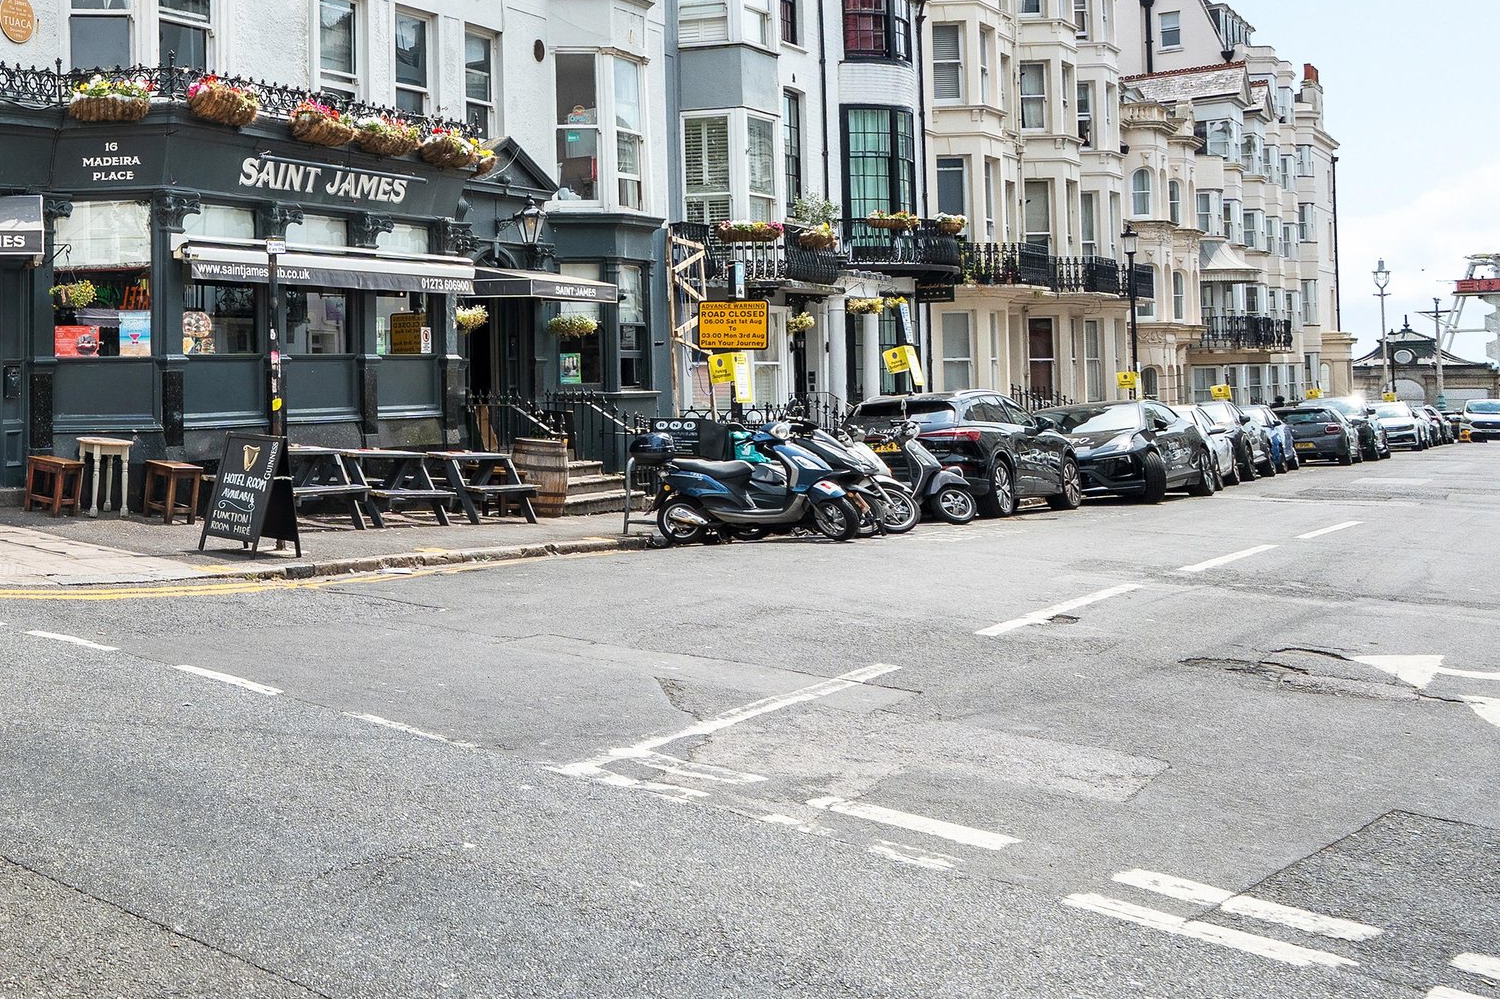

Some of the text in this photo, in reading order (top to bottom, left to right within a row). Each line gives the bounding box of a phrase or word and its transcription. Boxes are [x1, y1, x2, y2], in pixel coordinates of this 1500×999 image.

[3, 16, 32, 30] TUACA
[105, 142, 118, 152] 16
[82, 156, 141, 167] MADEIRA
[93, 171, 134, 181] PLACE
[239, 157, 408, 204] SAINT JAMES
[198, 264, 310, 280] www.saintjamesb.co.uk
[422, 278, 469, 291] 01273 606900
[556, 286, 596, 297] SAINT JAMES
[264, 442, 279, 480] GUINNESS
[223, 472, 245, 486] HOTEL
[211, 521, 251, 535] ROOM HIRE
